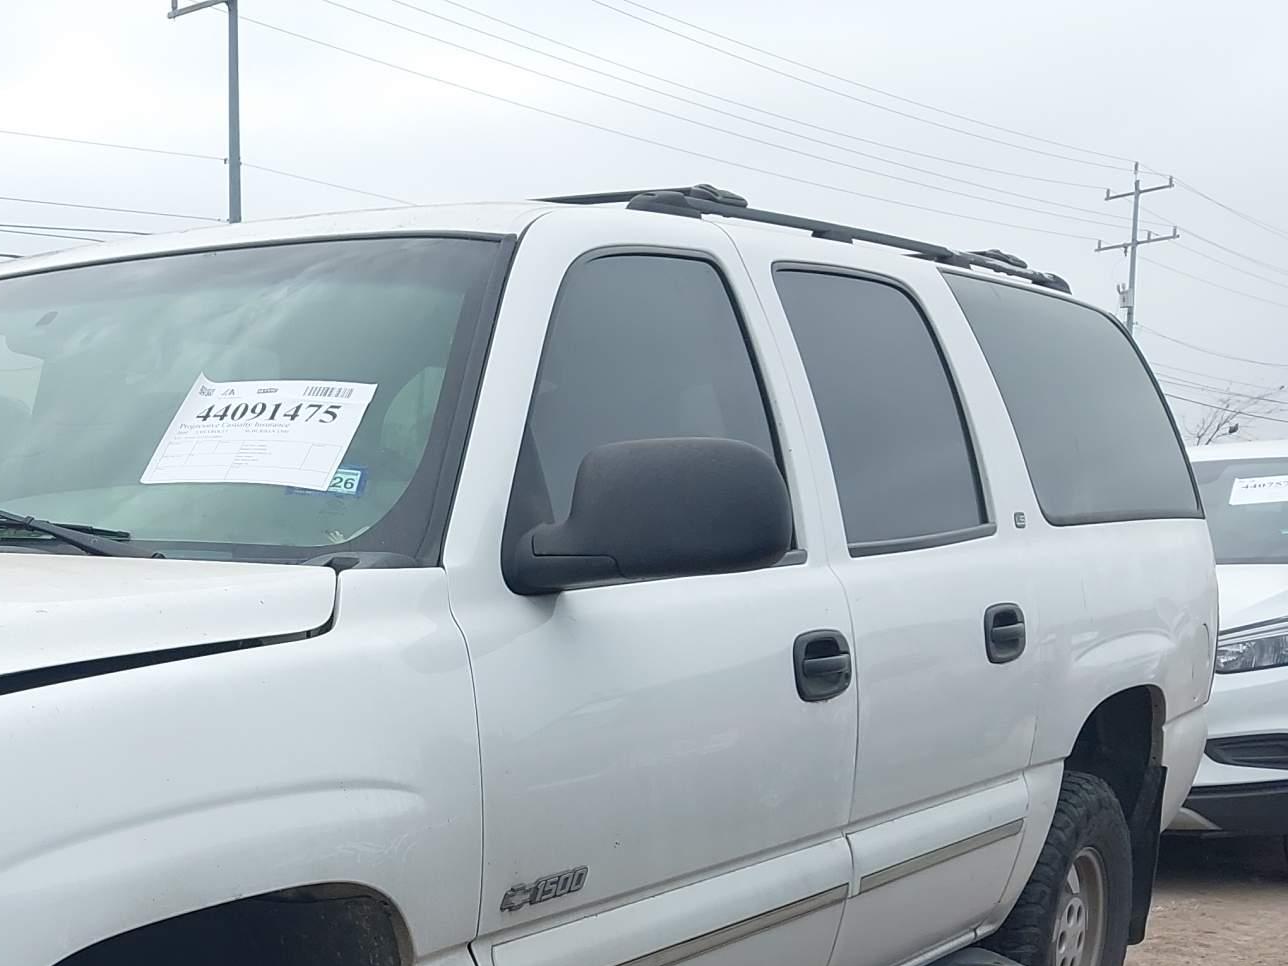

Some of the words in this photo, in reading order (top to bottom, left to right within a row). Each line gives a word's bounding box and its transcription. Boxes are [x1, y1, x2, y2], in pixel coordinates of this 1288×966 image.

[196, 402, 342, 423] 44091475
[330, 476, 356, 489] 26
[534, 866, 588, 903] 1500
